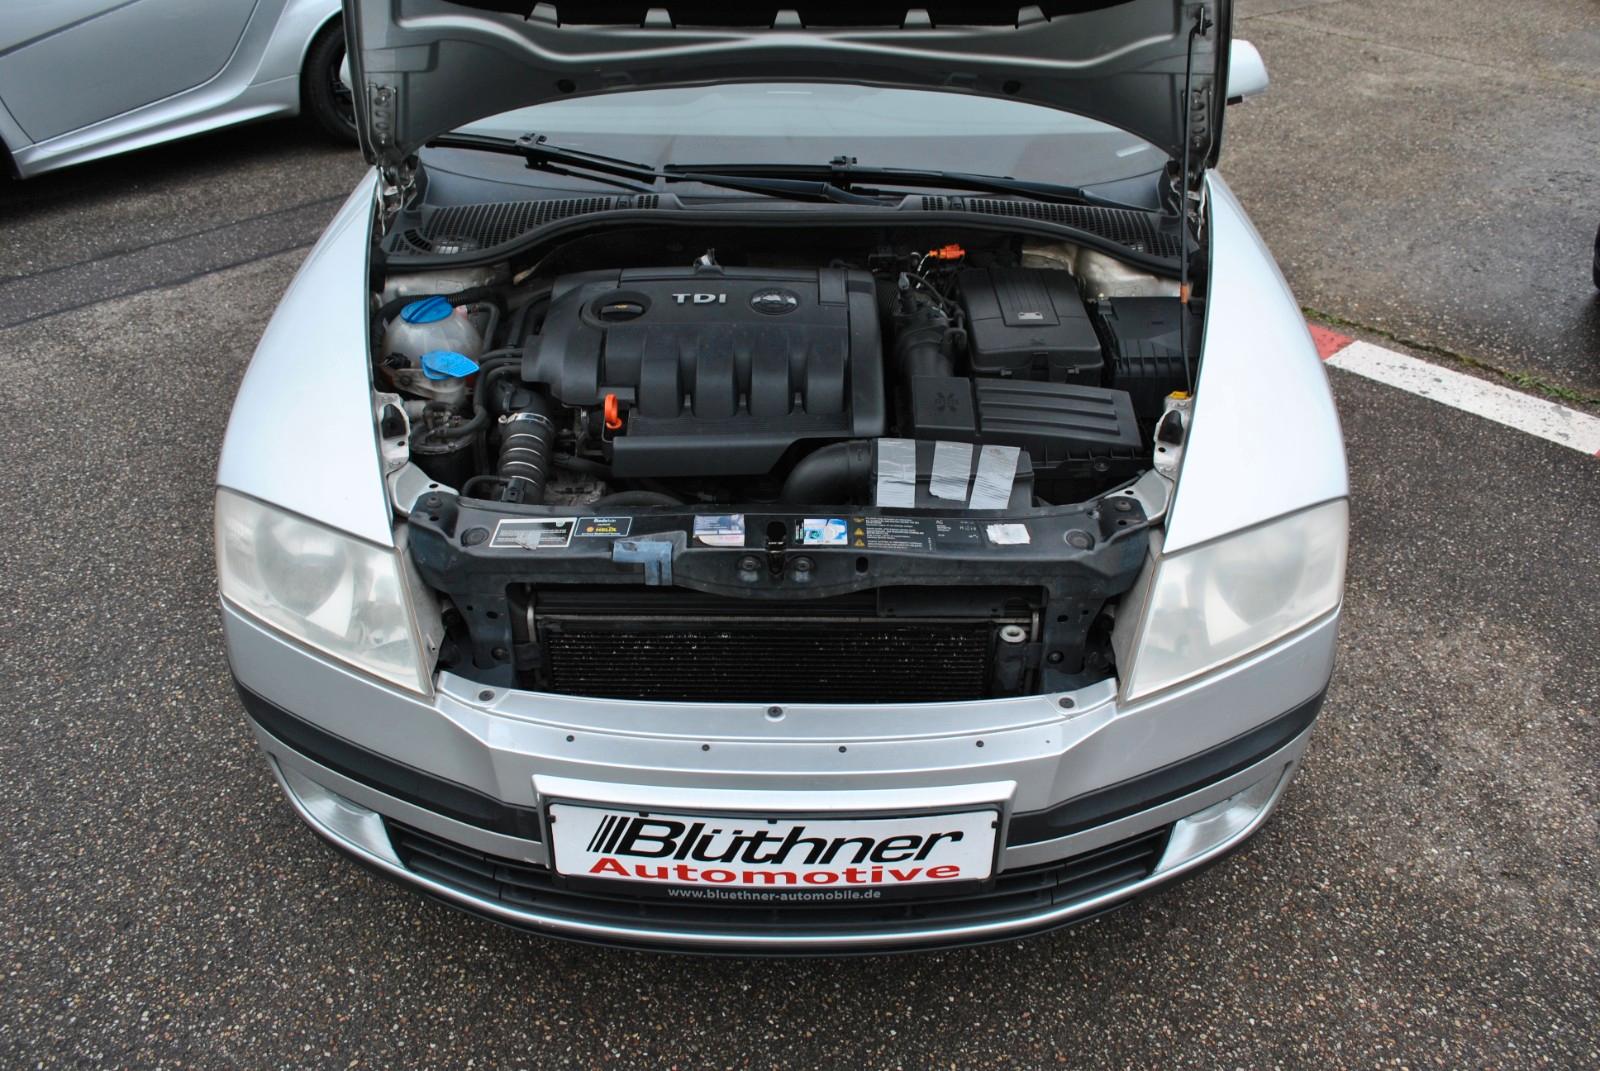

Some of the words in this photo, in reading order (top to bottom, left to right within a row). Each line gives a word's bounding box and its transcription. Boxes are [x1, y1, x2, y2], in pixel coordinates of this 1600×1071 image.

[672, 293, 727, 304] TDI
[613, 816, 964, 865] Blüthner
[589, 857, 961, 885] Automotive
[667, 887, 881, 901] www.bluethner-automobile.de
